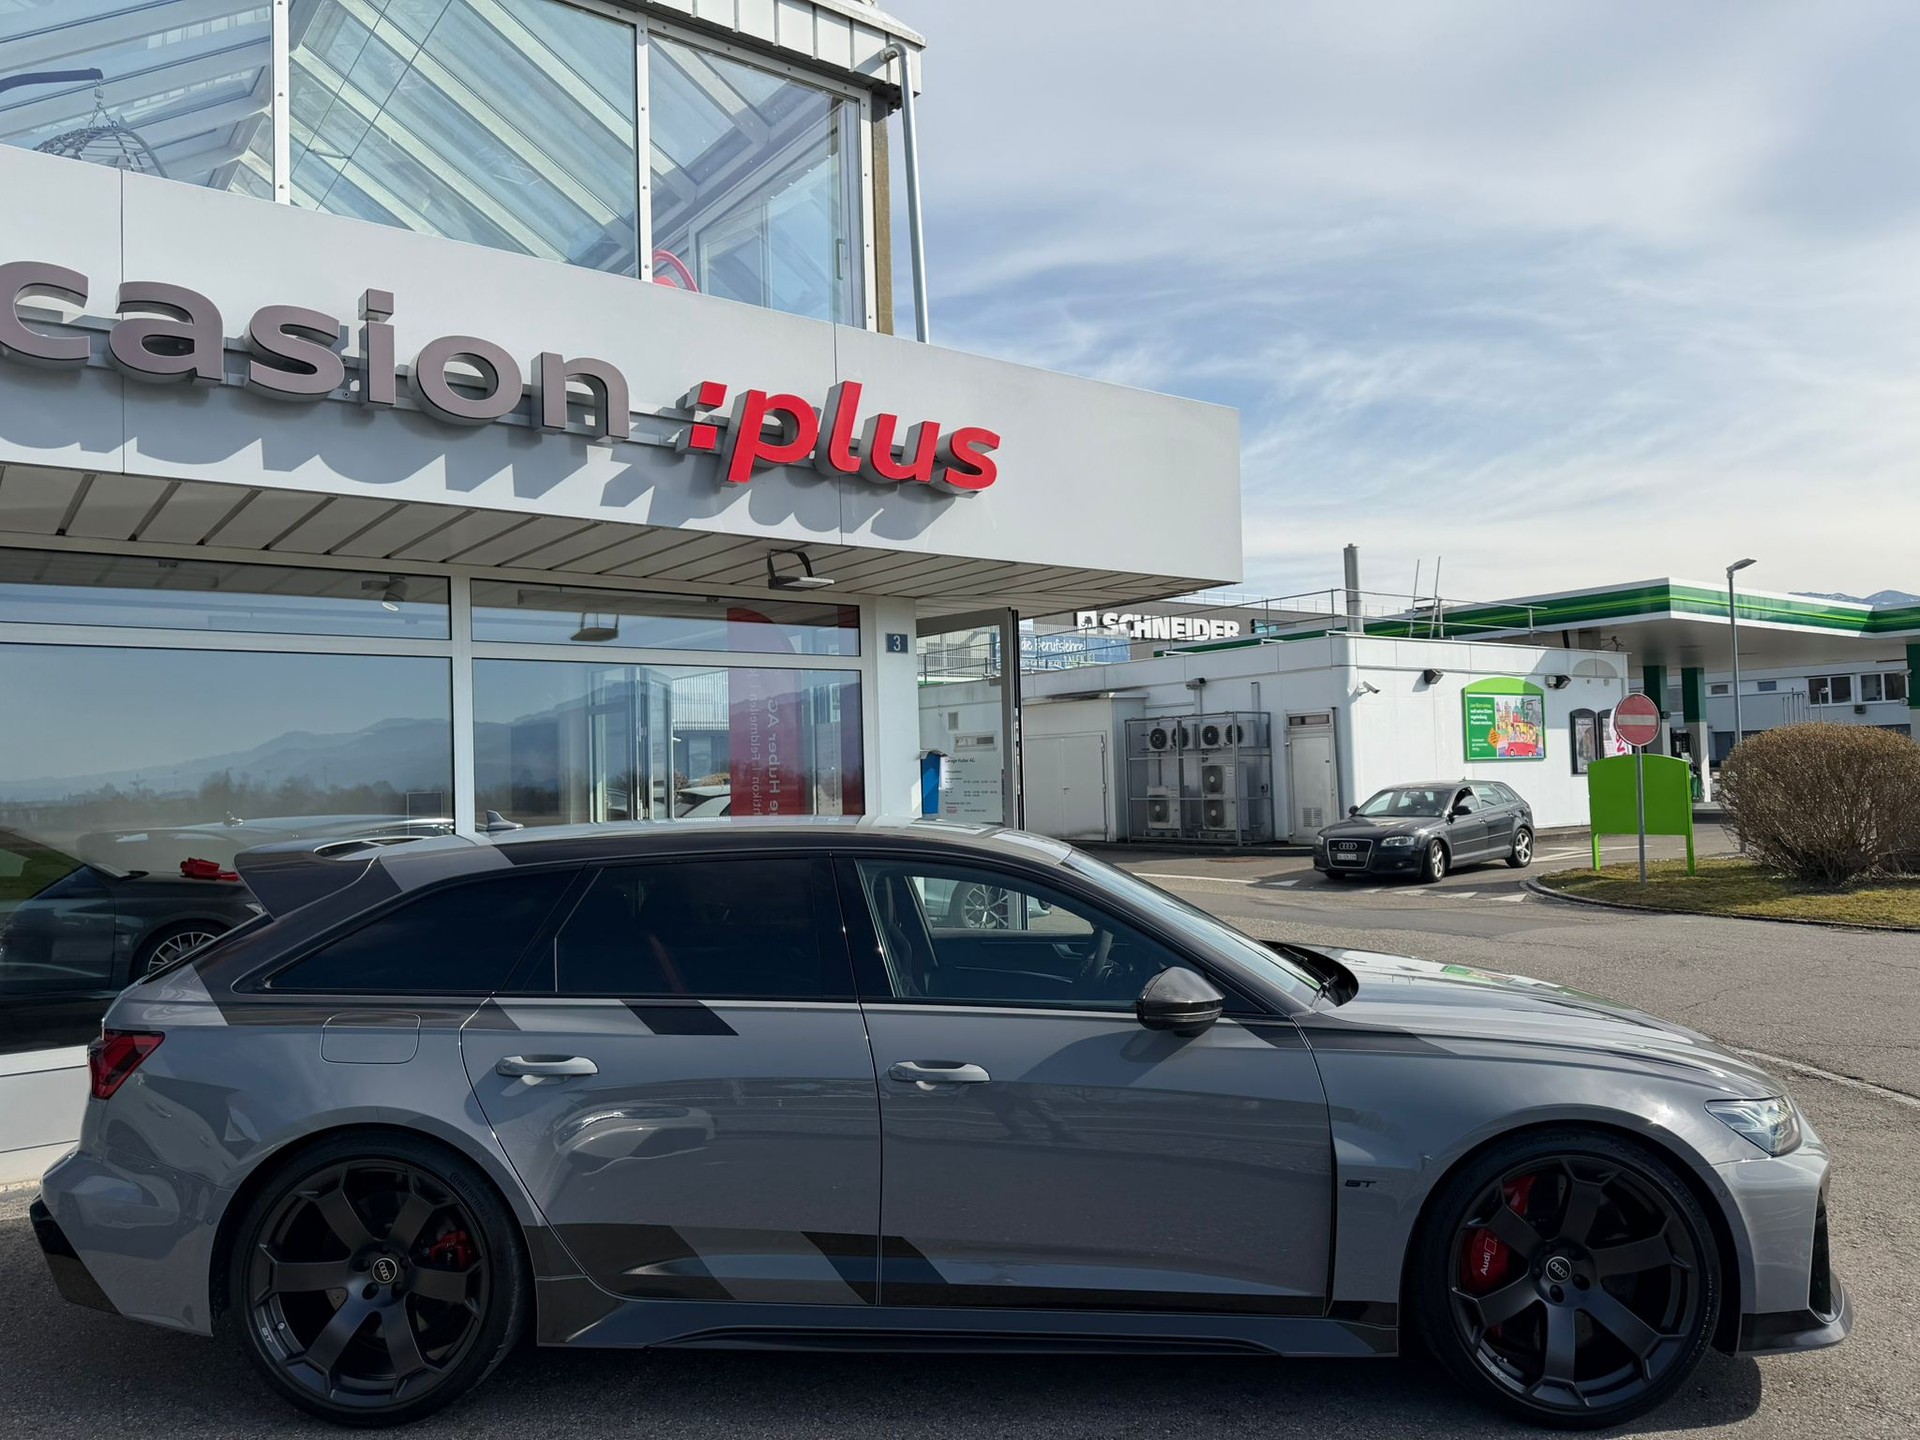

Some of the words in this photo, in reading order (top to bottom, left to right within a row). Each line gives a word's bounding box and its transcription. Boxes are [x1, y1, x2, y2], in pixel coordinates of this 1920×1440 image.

[0, 261, 630, 442] casion
[1102, 612, 1241, 641] SCHNEIDER
[893, 635, 901, 652] 3
[1344, 1179, 1377, 1188] GT
[1480, 1252, 1492, 1276] Audi
